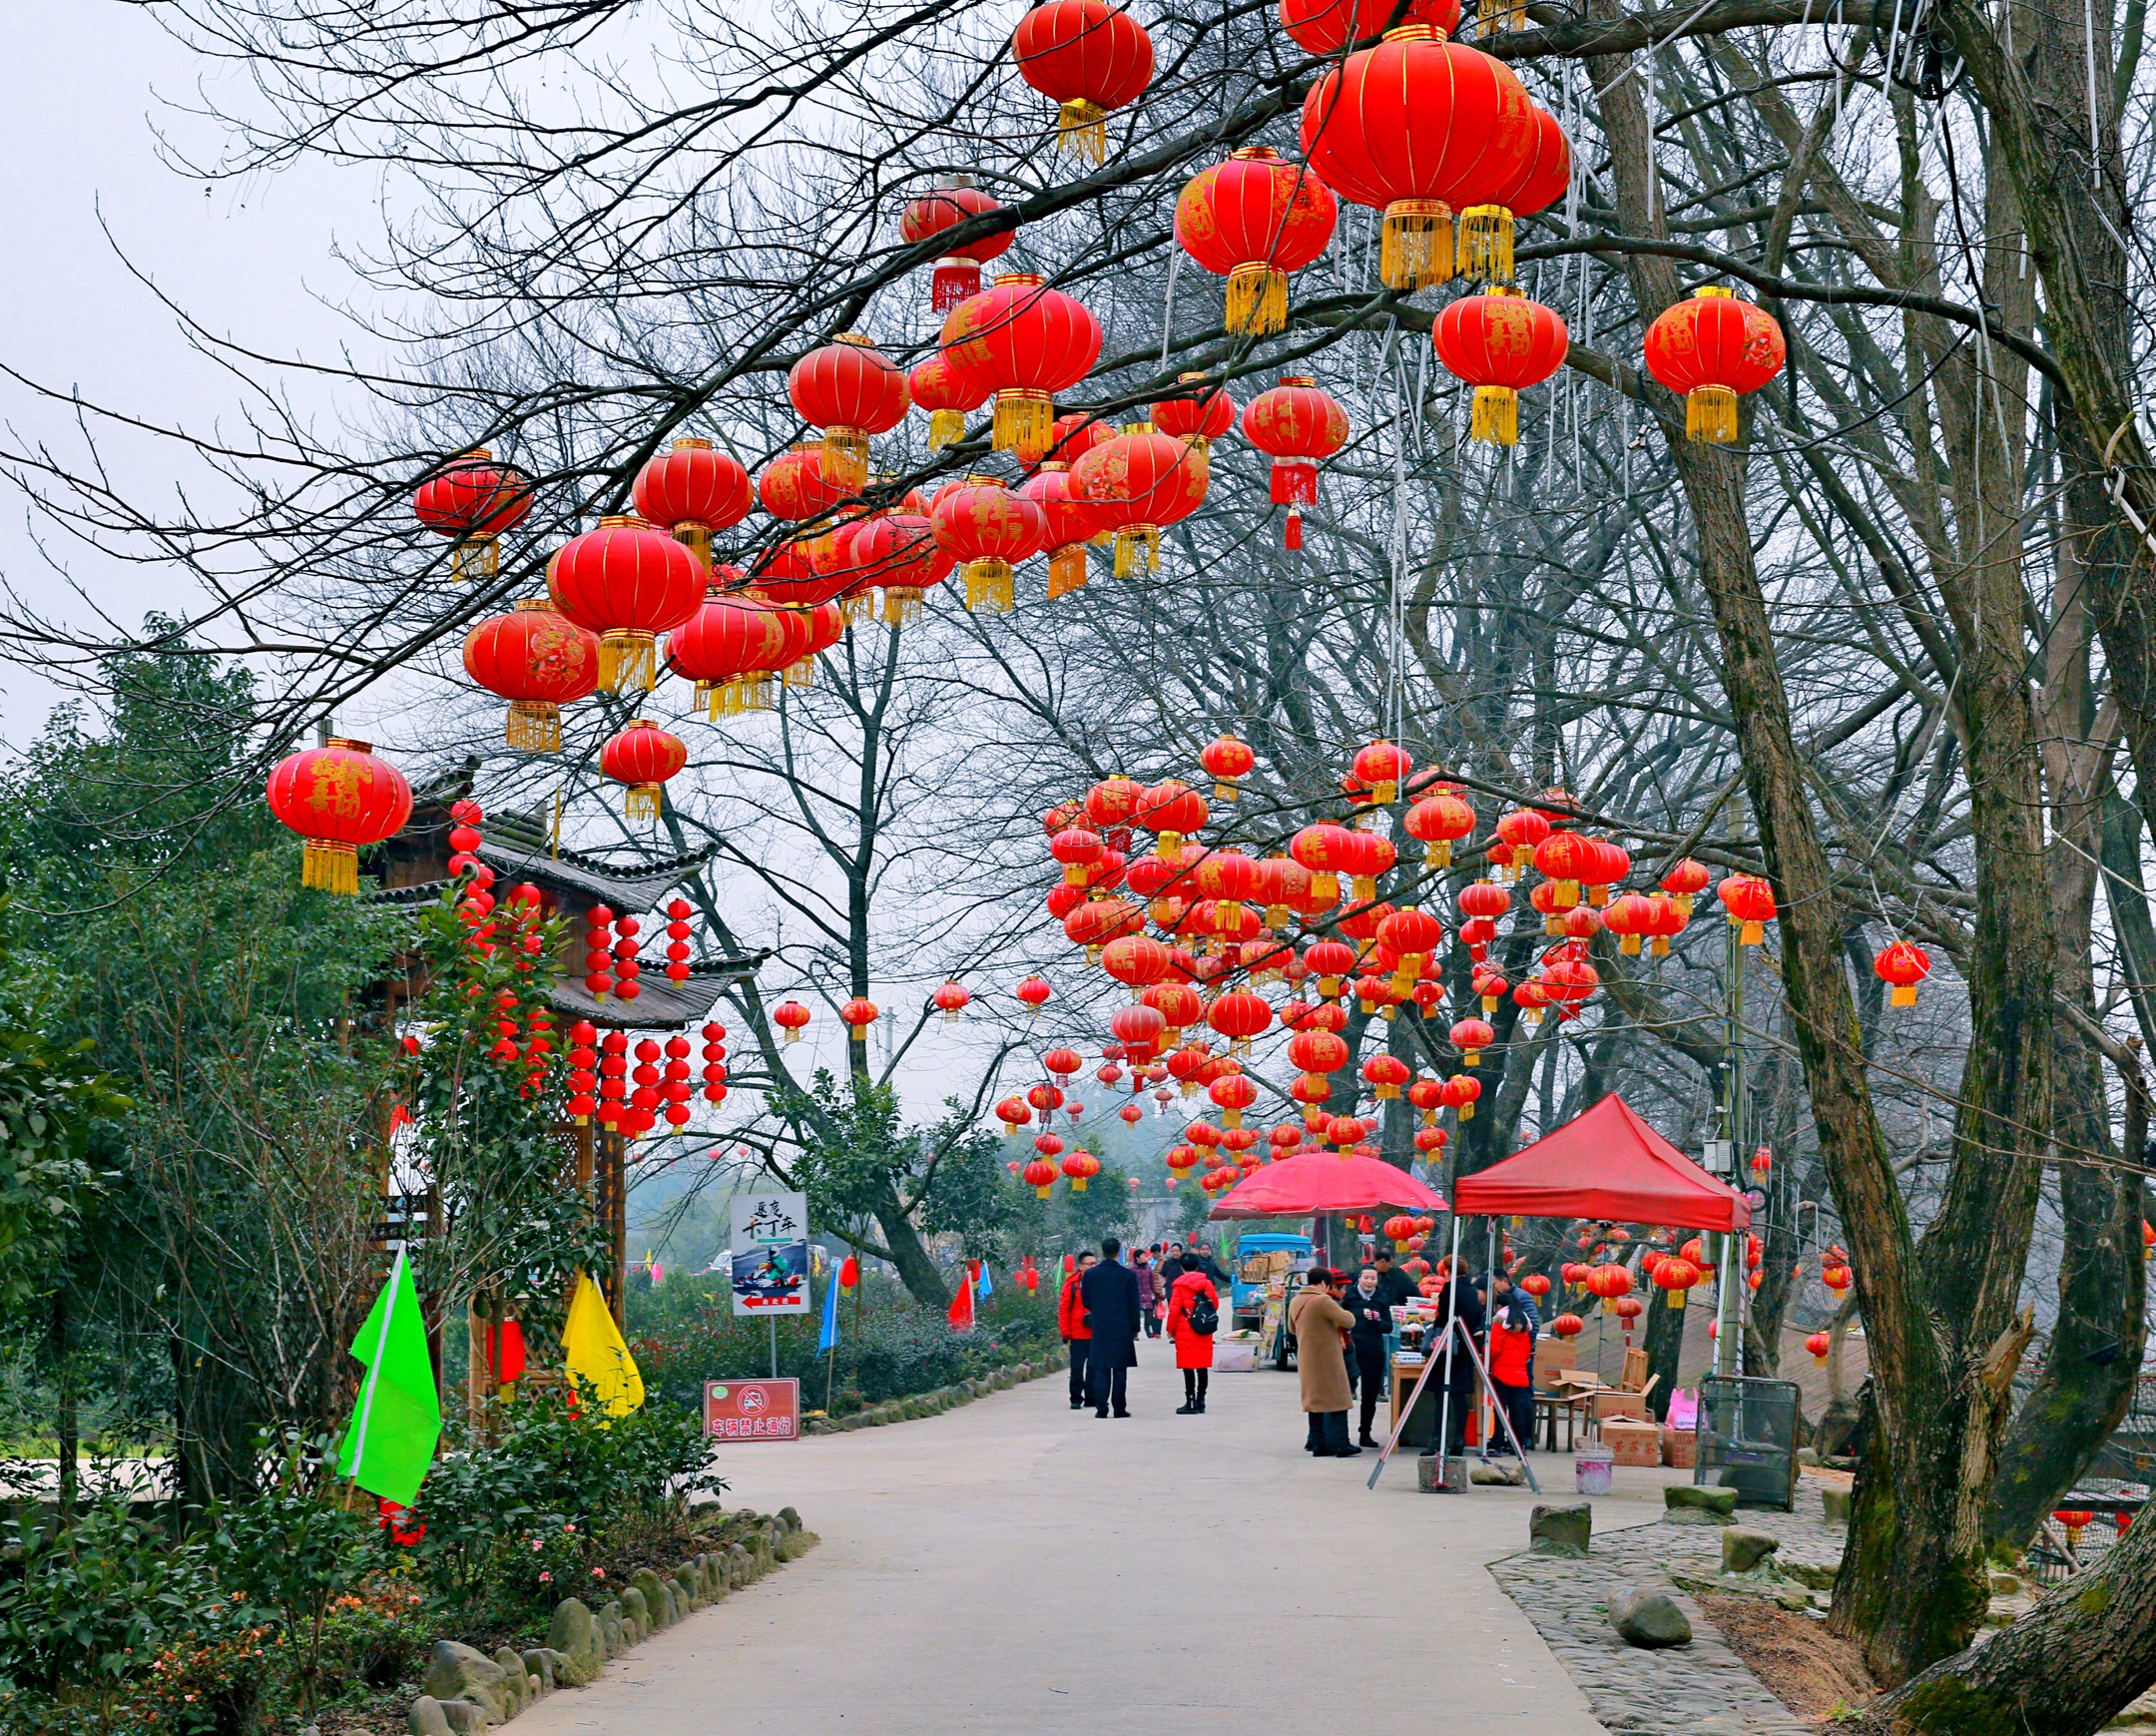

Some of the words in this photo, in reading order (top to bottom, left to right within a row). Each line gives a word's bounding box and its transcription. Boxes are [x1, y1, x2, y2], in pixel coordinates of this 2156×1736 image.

[742, 1215, 798, 1239] 卡丁车
[712, 1417, 792, 1437] 车辆禁止通行
